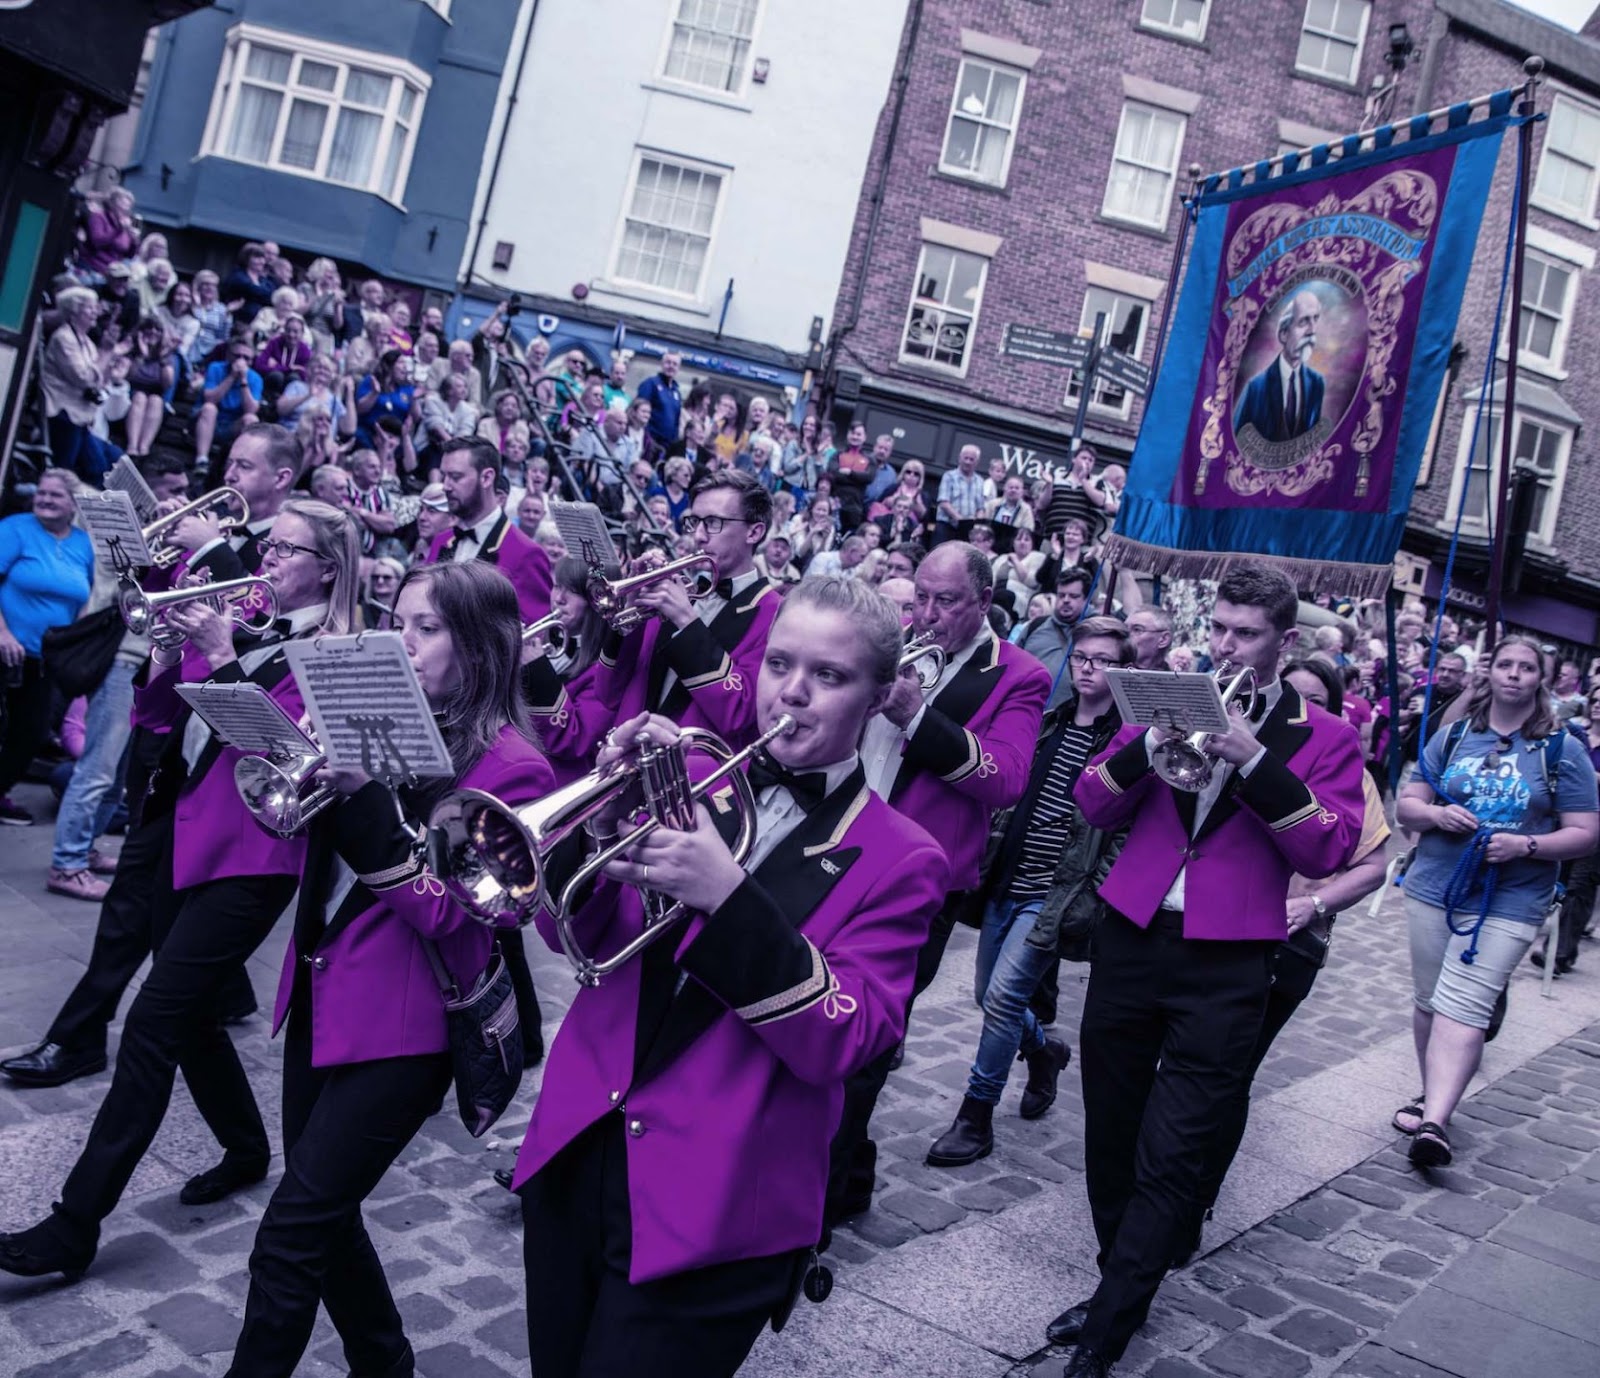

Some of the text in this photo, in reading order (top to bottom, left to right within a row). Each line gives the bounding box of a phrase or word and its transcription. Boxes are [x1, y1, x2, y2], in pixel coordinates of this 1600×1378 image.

[1235, 242, 1281, 293] DURHAM
[1336, 214, 1416, 258] ASSOCIATION
[1000, 443, 1068, 480] Wate
